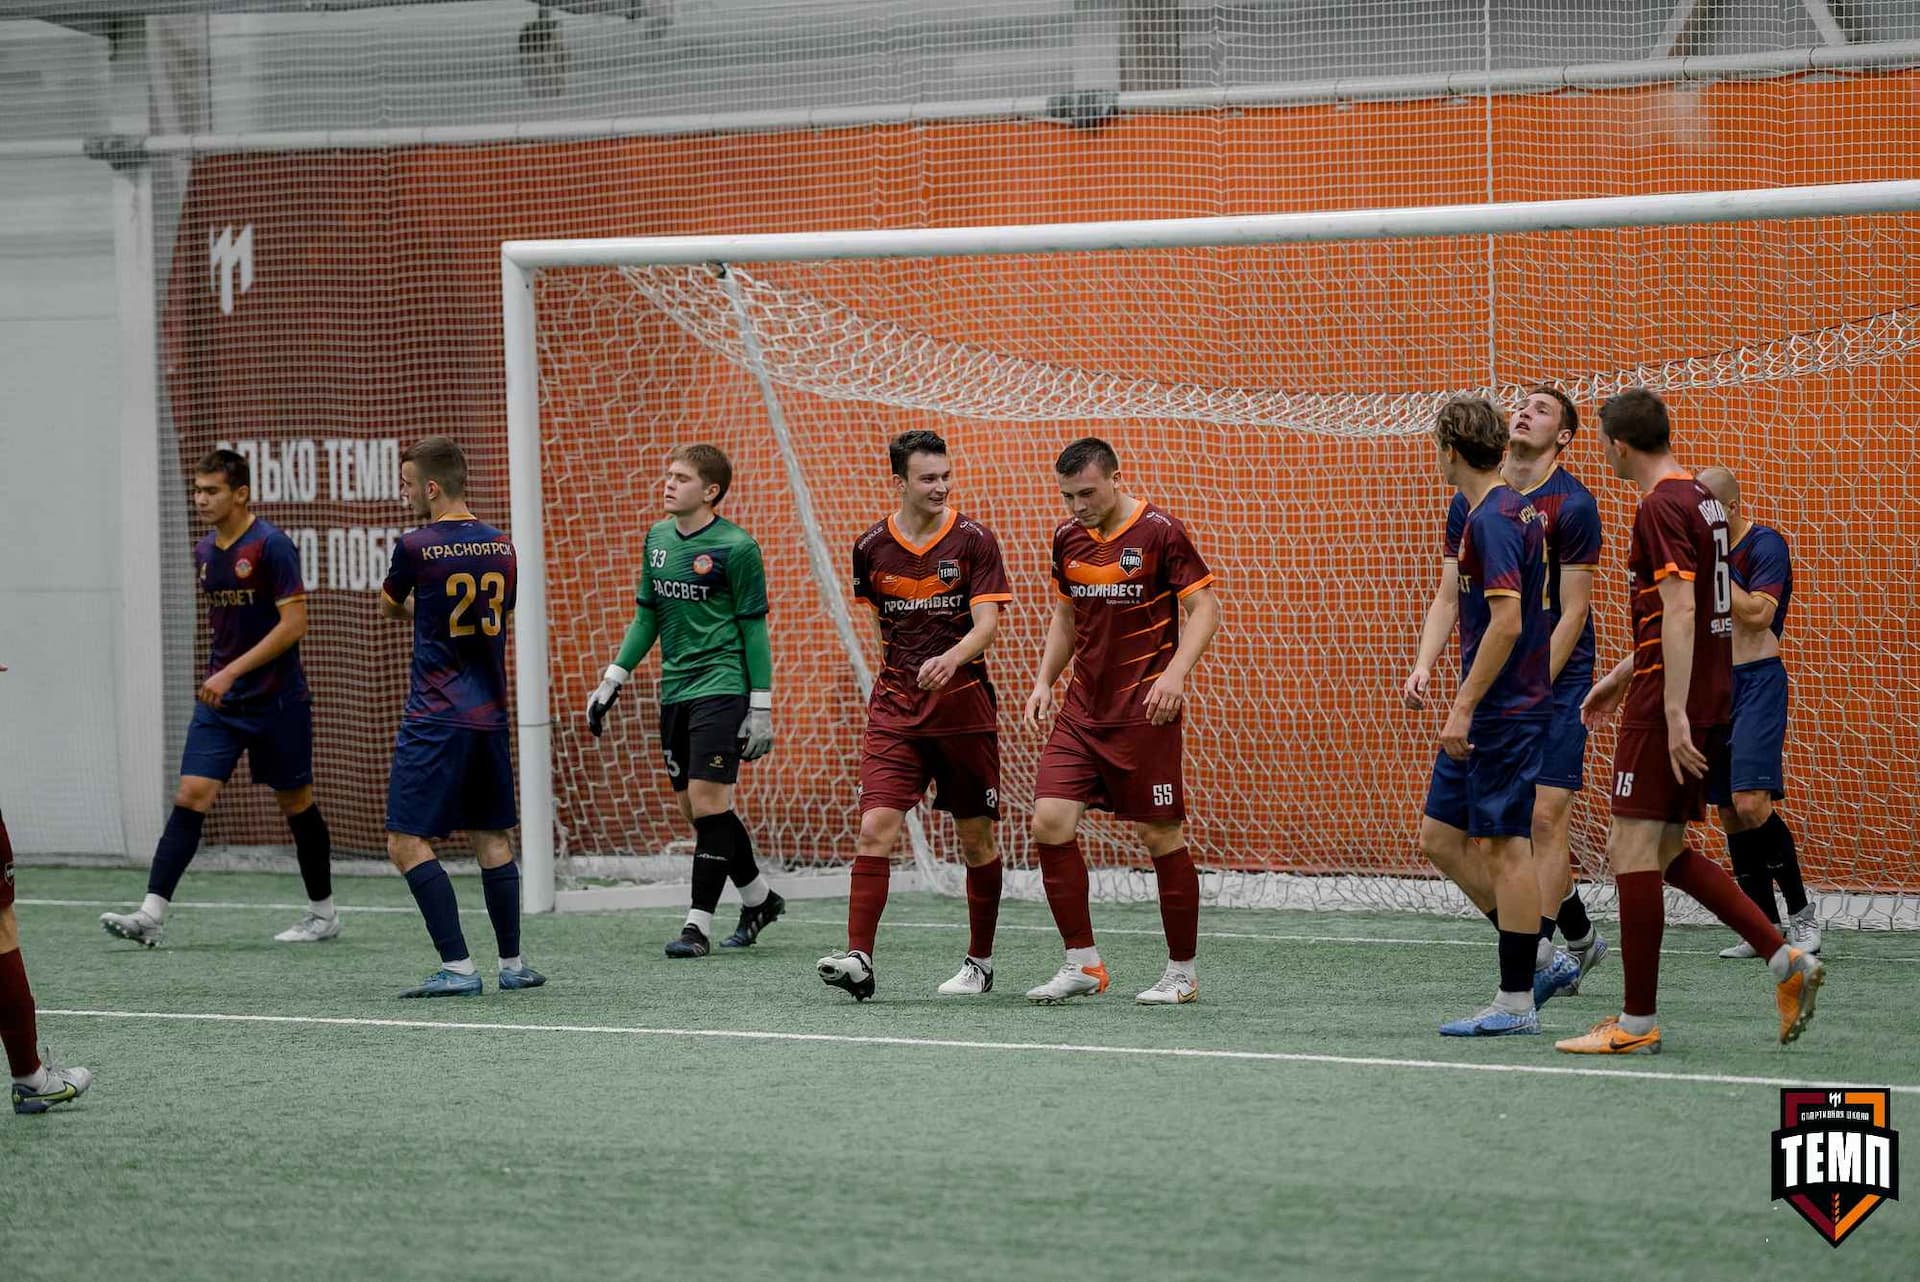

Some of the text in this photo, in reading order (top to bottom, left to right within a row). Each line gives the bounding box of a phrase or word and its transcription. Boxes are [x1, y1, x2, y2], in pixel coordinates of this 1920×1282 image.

[650, 548, 667, 569] 33
[446, 571, 505, 638] 23
[1152, 783, 1174, 806] 55
